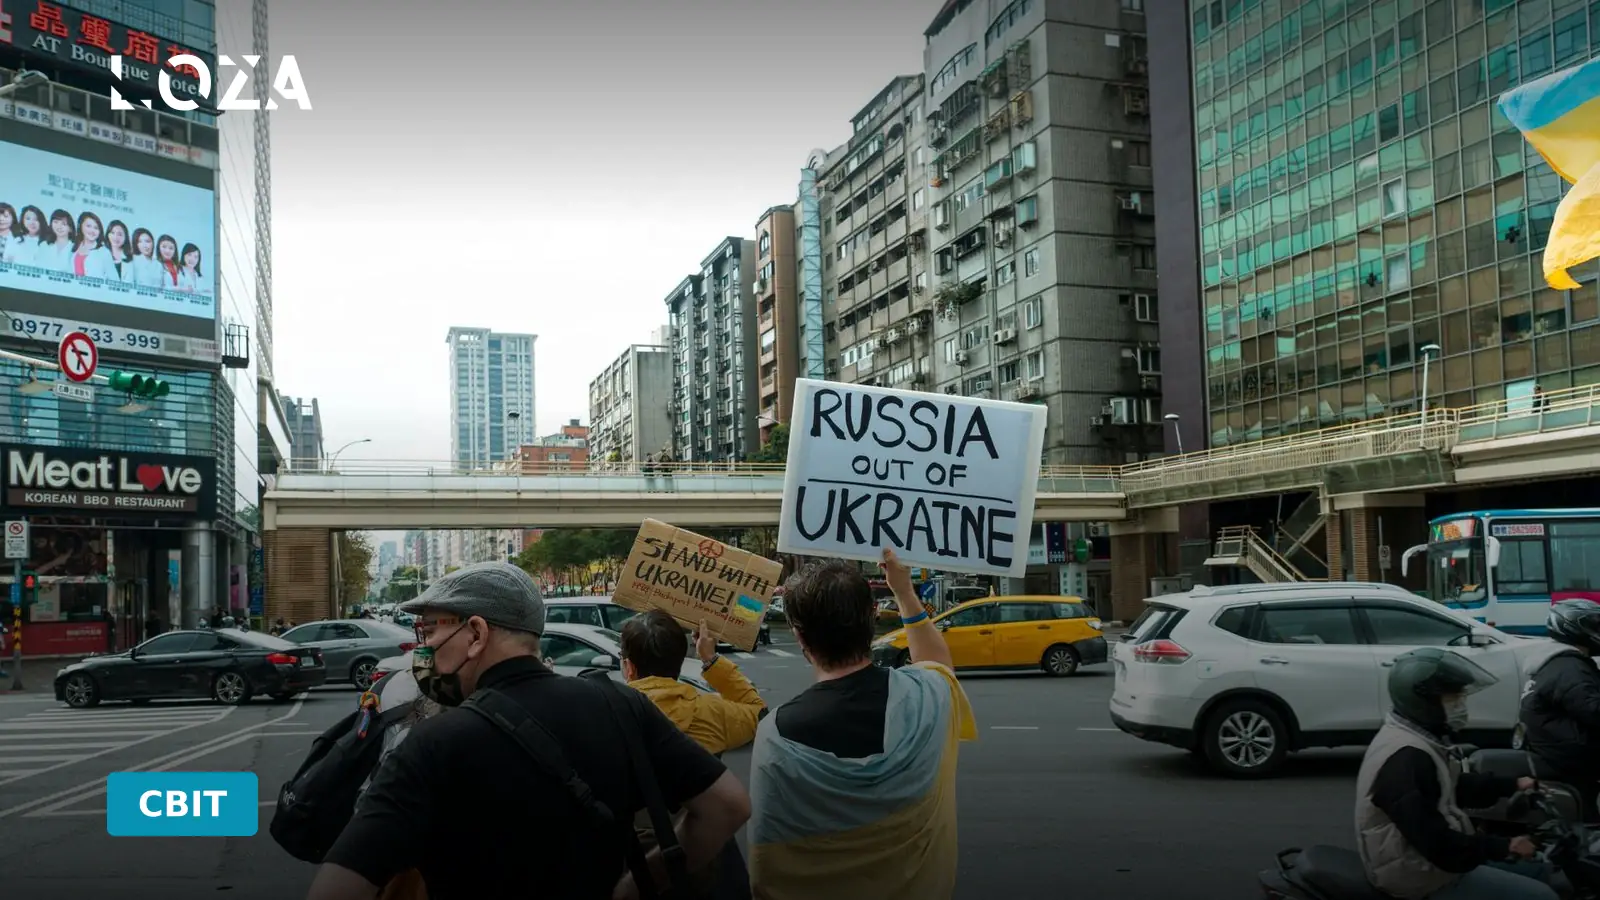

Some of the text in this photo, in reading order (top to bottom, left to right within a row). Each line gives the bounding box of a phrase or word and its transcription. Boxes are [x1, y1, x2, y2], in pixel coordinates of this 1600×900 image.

[32, 33, 61, 54] AT
[70, 44, 149, 80] Boutque
[11, 318, 63, 337] 0977
[810, 387, 1000, 460] RUSSIA
[8, 450, 115, 489] Meat
[851, 455, 968, 487] OUT OF
[25, 492, 187, 509] KOREAN BBQ RESTAURANT
[795, 485, 1017, 568] UKRAINE
[634, 560, 736, 613] UKRAINE!
[641, 537, 769, 596] STAND WITH
